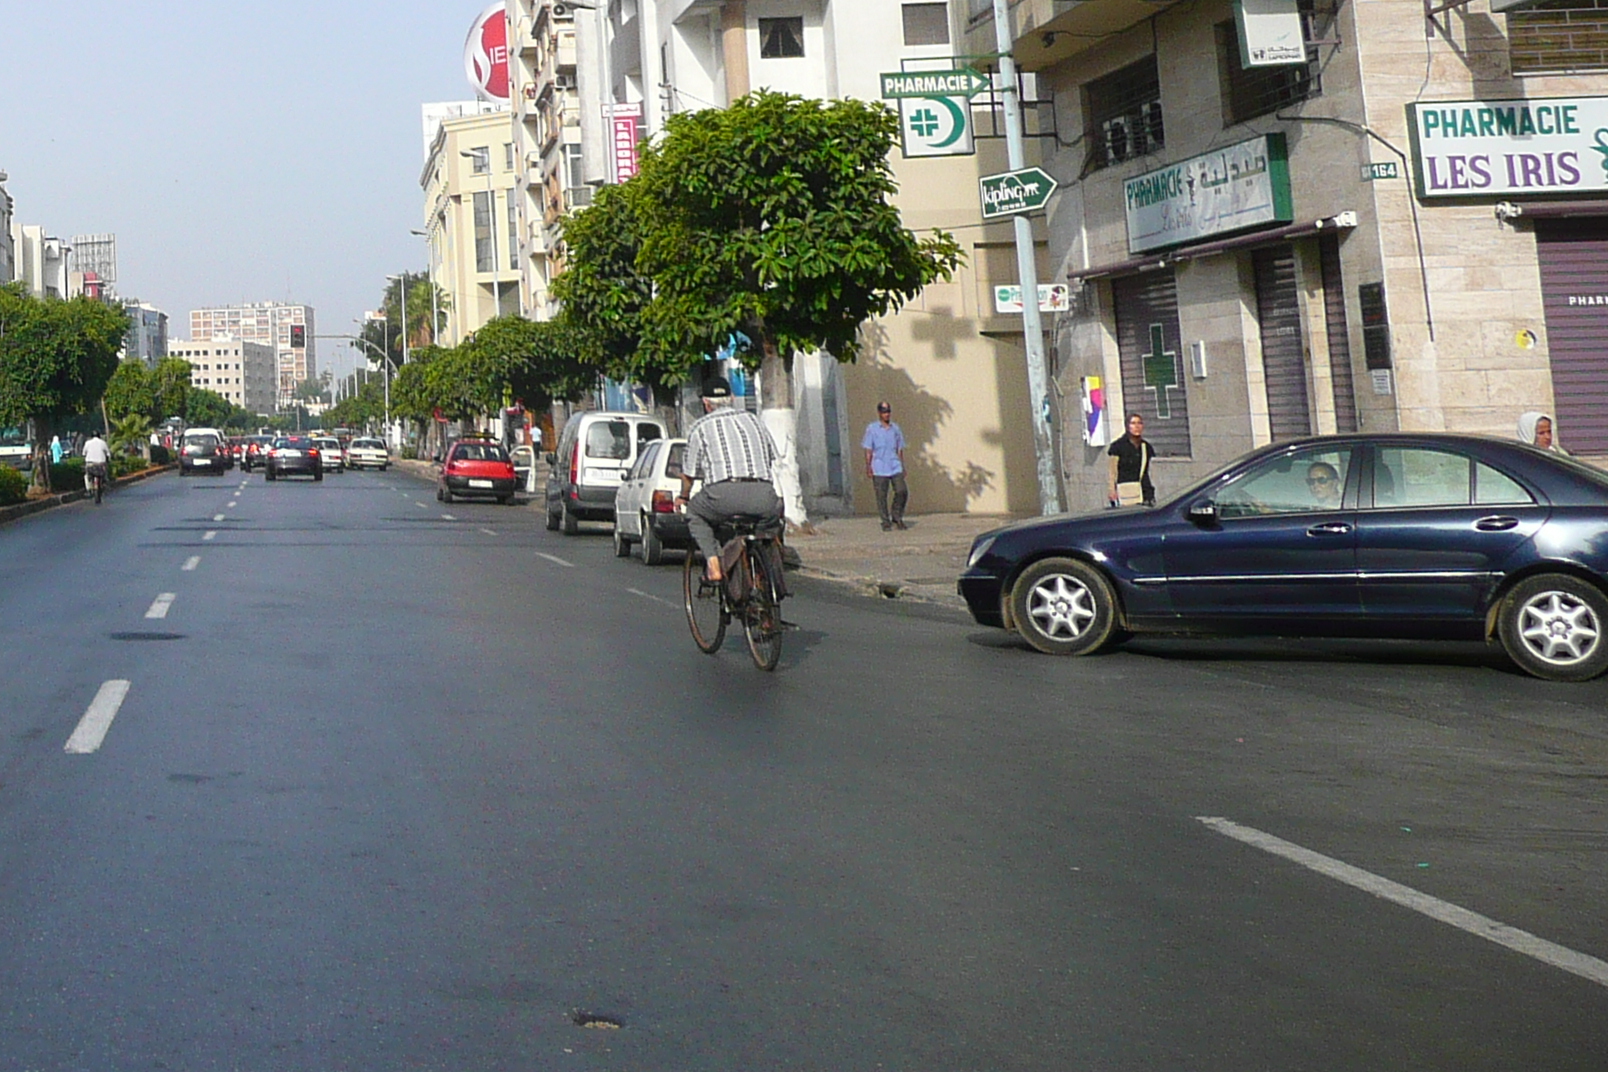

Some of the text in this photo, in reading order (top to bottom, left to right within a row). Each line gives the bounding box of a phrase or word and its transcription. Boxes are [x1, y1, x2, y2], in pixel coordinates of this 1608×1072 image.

[884, 74, 970, 94] PHARMACIE
[1422, 104, 1581, 139] PHARMACIE
[1426, 151, 1581, 190] LES IRIS
[1126, 168, 1183, 211] PHARMACIE
